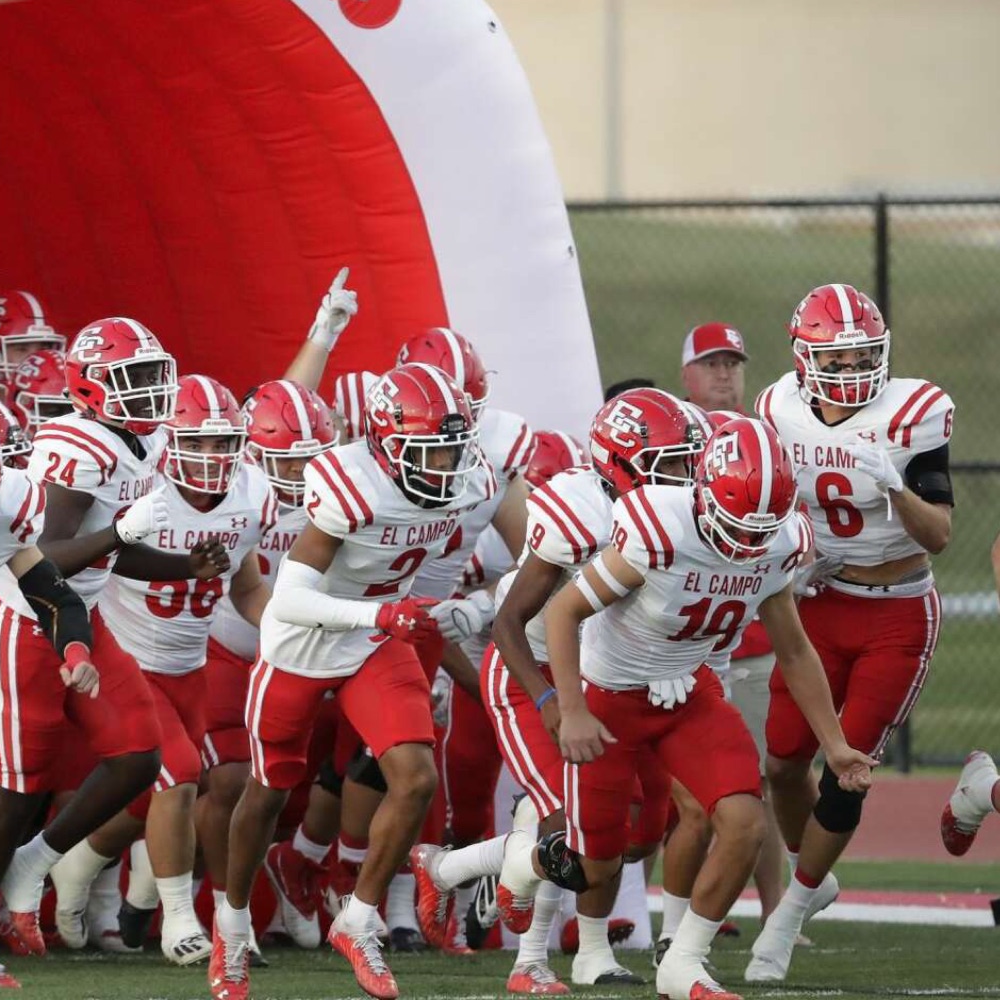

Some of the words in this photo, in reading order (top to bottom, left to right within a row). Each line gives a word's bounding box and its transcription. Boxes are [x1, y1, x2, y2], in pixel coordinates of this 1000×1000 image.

[793, 443, 808, 465] EL
[815, 446, 857, 468] CAM
[44, 452, 78, 487] 24
[815, 472, 864, 537] 6
[158, 529, 177, 550] EL
[259, 532, 297, 551] CAM
[380, 527, 398, 546] EL
[406, 519, 456, 546] CAMPO
[363, 548, 427, 597] 2
[684, 572, 702, 593] EL
[709, 574, 762, 597] CAMPO
[667, 597, 747, 652] 19
